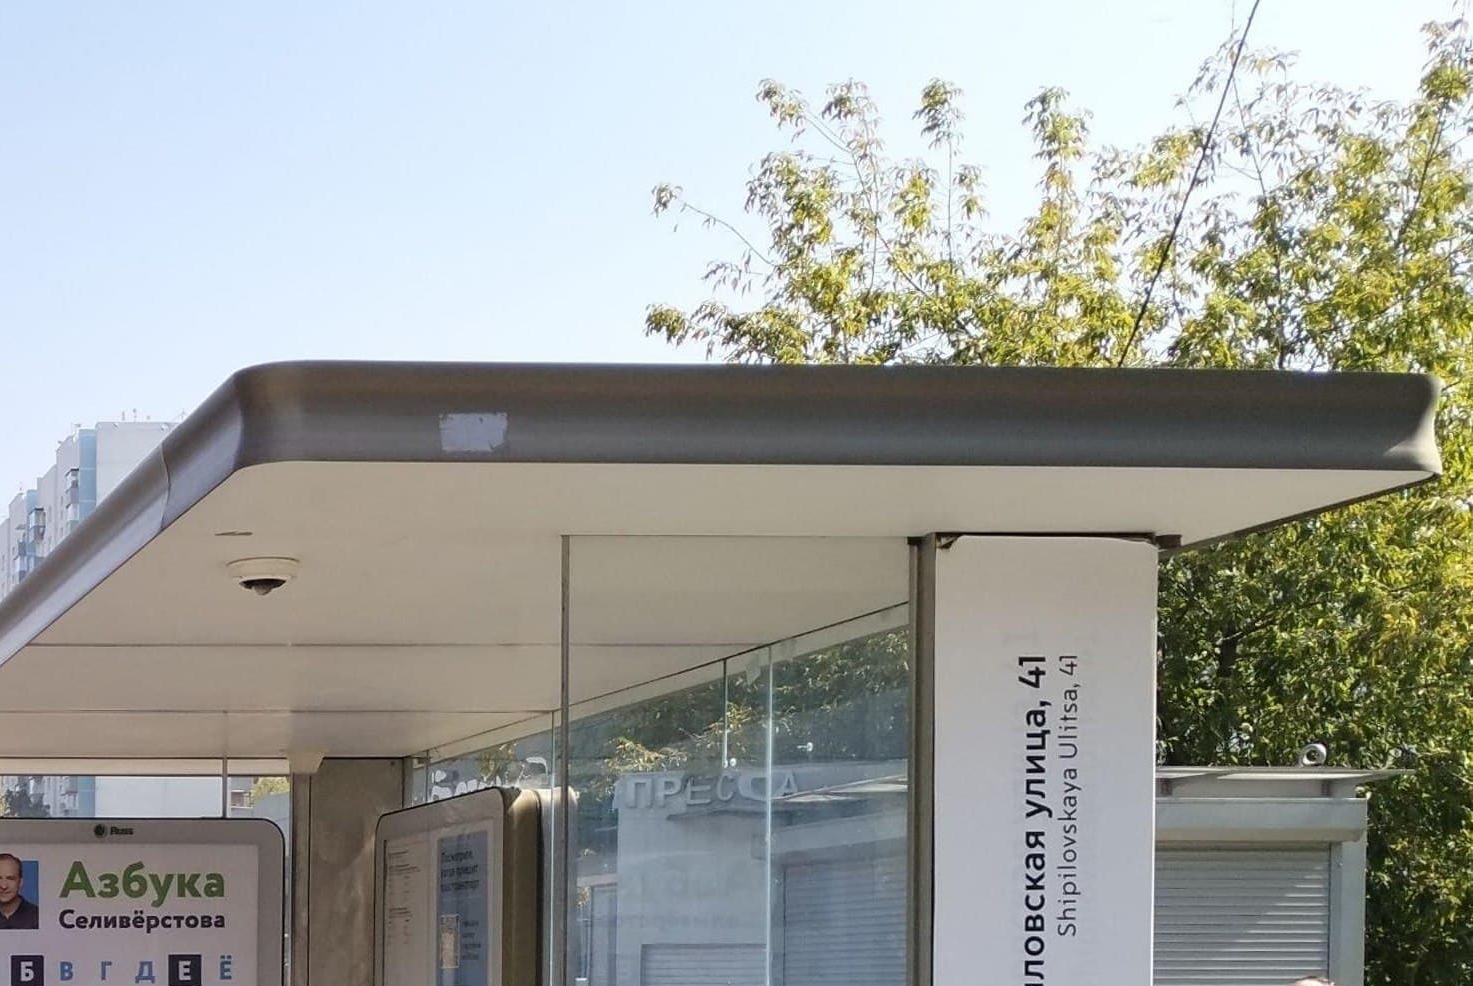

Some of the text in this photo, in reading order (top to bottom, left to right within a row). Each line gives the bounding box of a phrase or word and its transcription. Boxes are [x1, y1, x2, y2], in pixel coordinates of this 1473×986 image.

[1018, 656, 1045, 689] 41
[1025, 700, 1053, 819] улица,
[629, 769, 800, 809] ПРЕССА
[1057, 655, 1082, 937] Shipilovskaya Ulitsa, 41
[59, 861, 225, 908] Азбука
[59, 909, 225, 933] Селивёрстова
[20, 961, 34, 982] Б
[59, 961, 74, 981] В
[101, 961, 113, 981] Г
[135, 961, 156, 984] Д
[178, 960, 192, 981] Е
[219, 955, 232, 980] Ё
